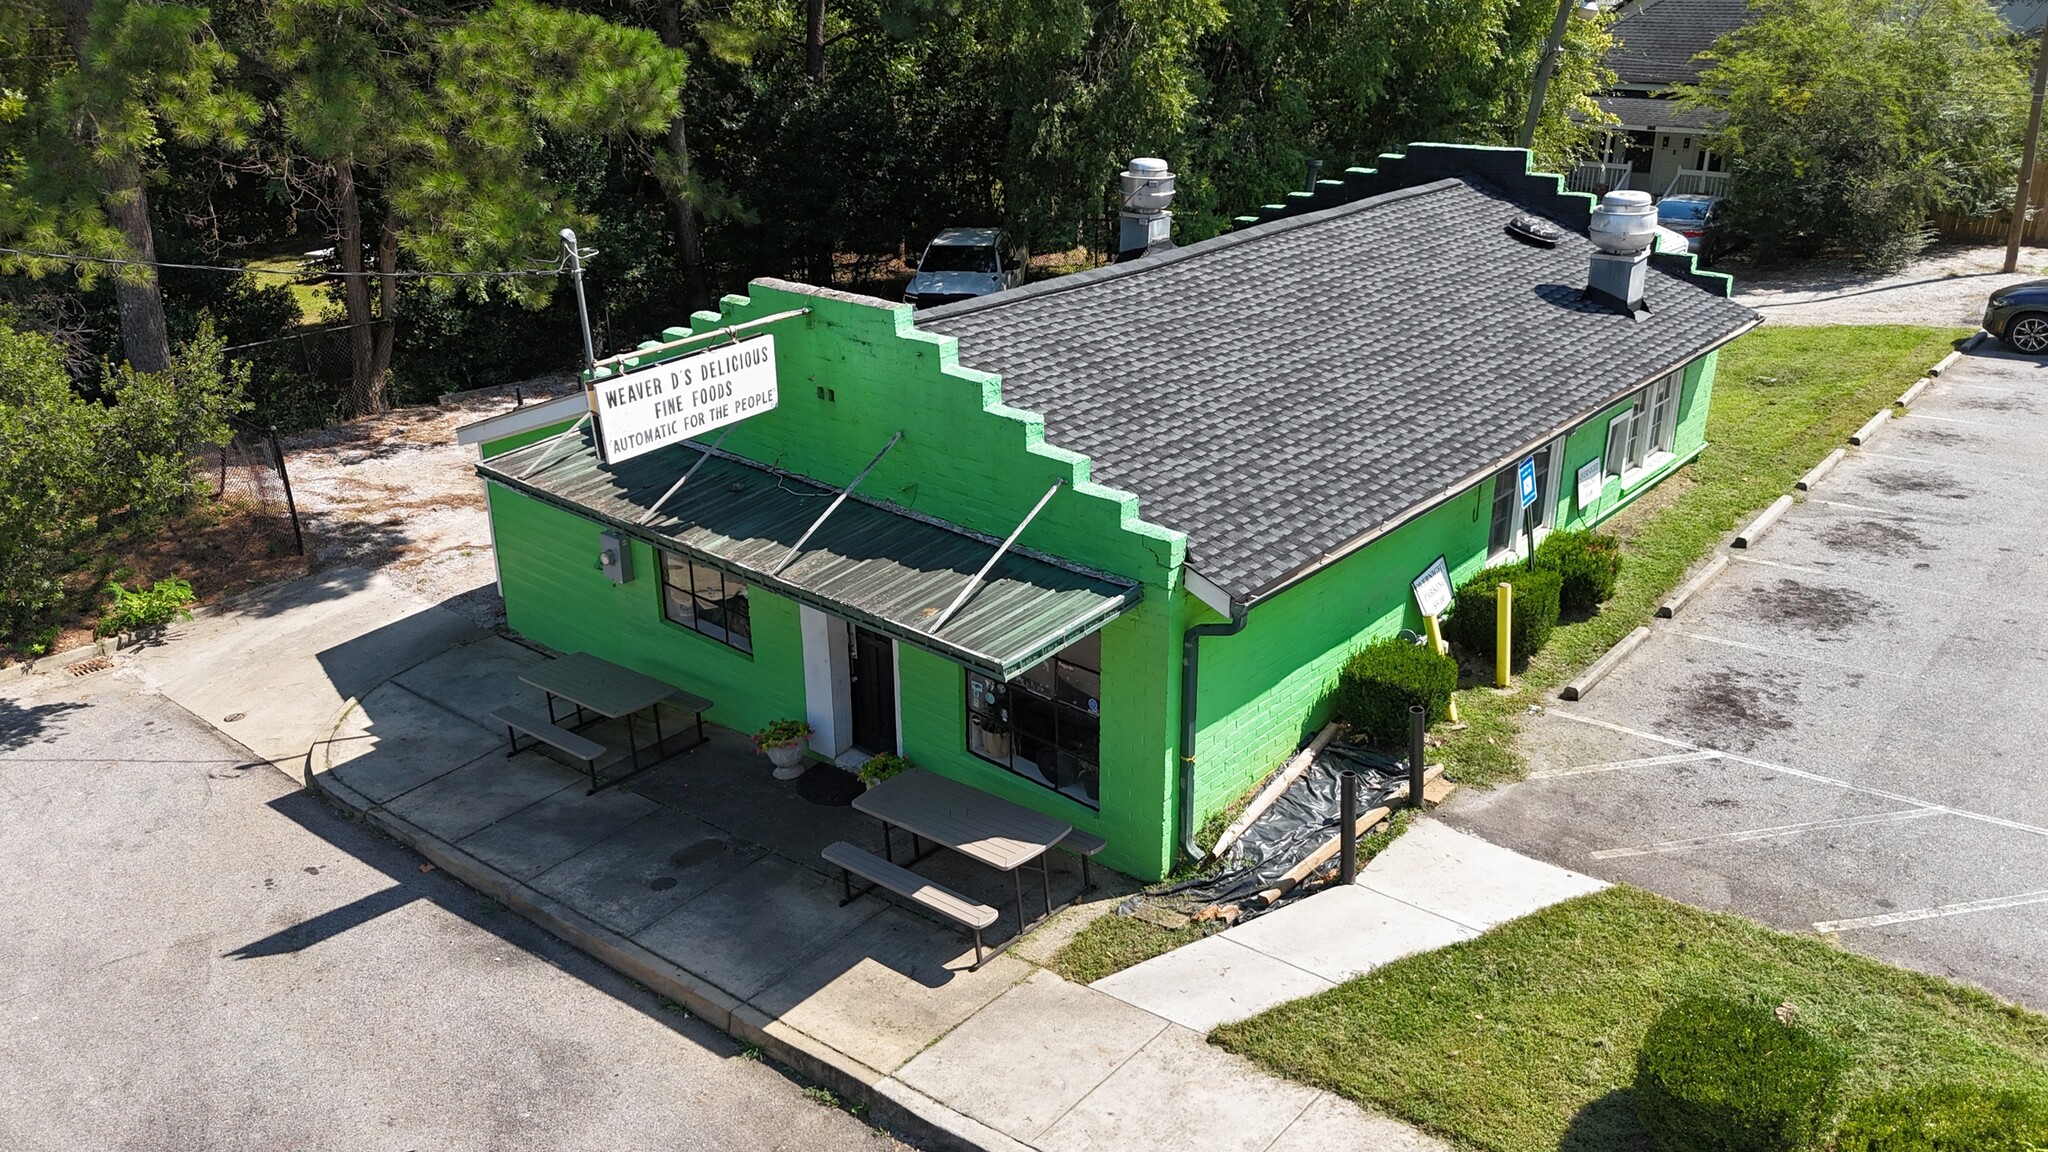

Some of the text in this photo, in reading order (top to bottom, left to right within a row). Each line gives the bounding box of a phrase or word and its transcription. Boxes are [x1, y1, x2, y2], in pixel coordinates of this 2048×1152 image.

[605, 346, 769, 409] WEAVER D'S DELICIOUS
[654, 380, 733, 419] FINE FOODS
[684, 412, 706, 430] FOR
[709, 404, 729, 422] THE
